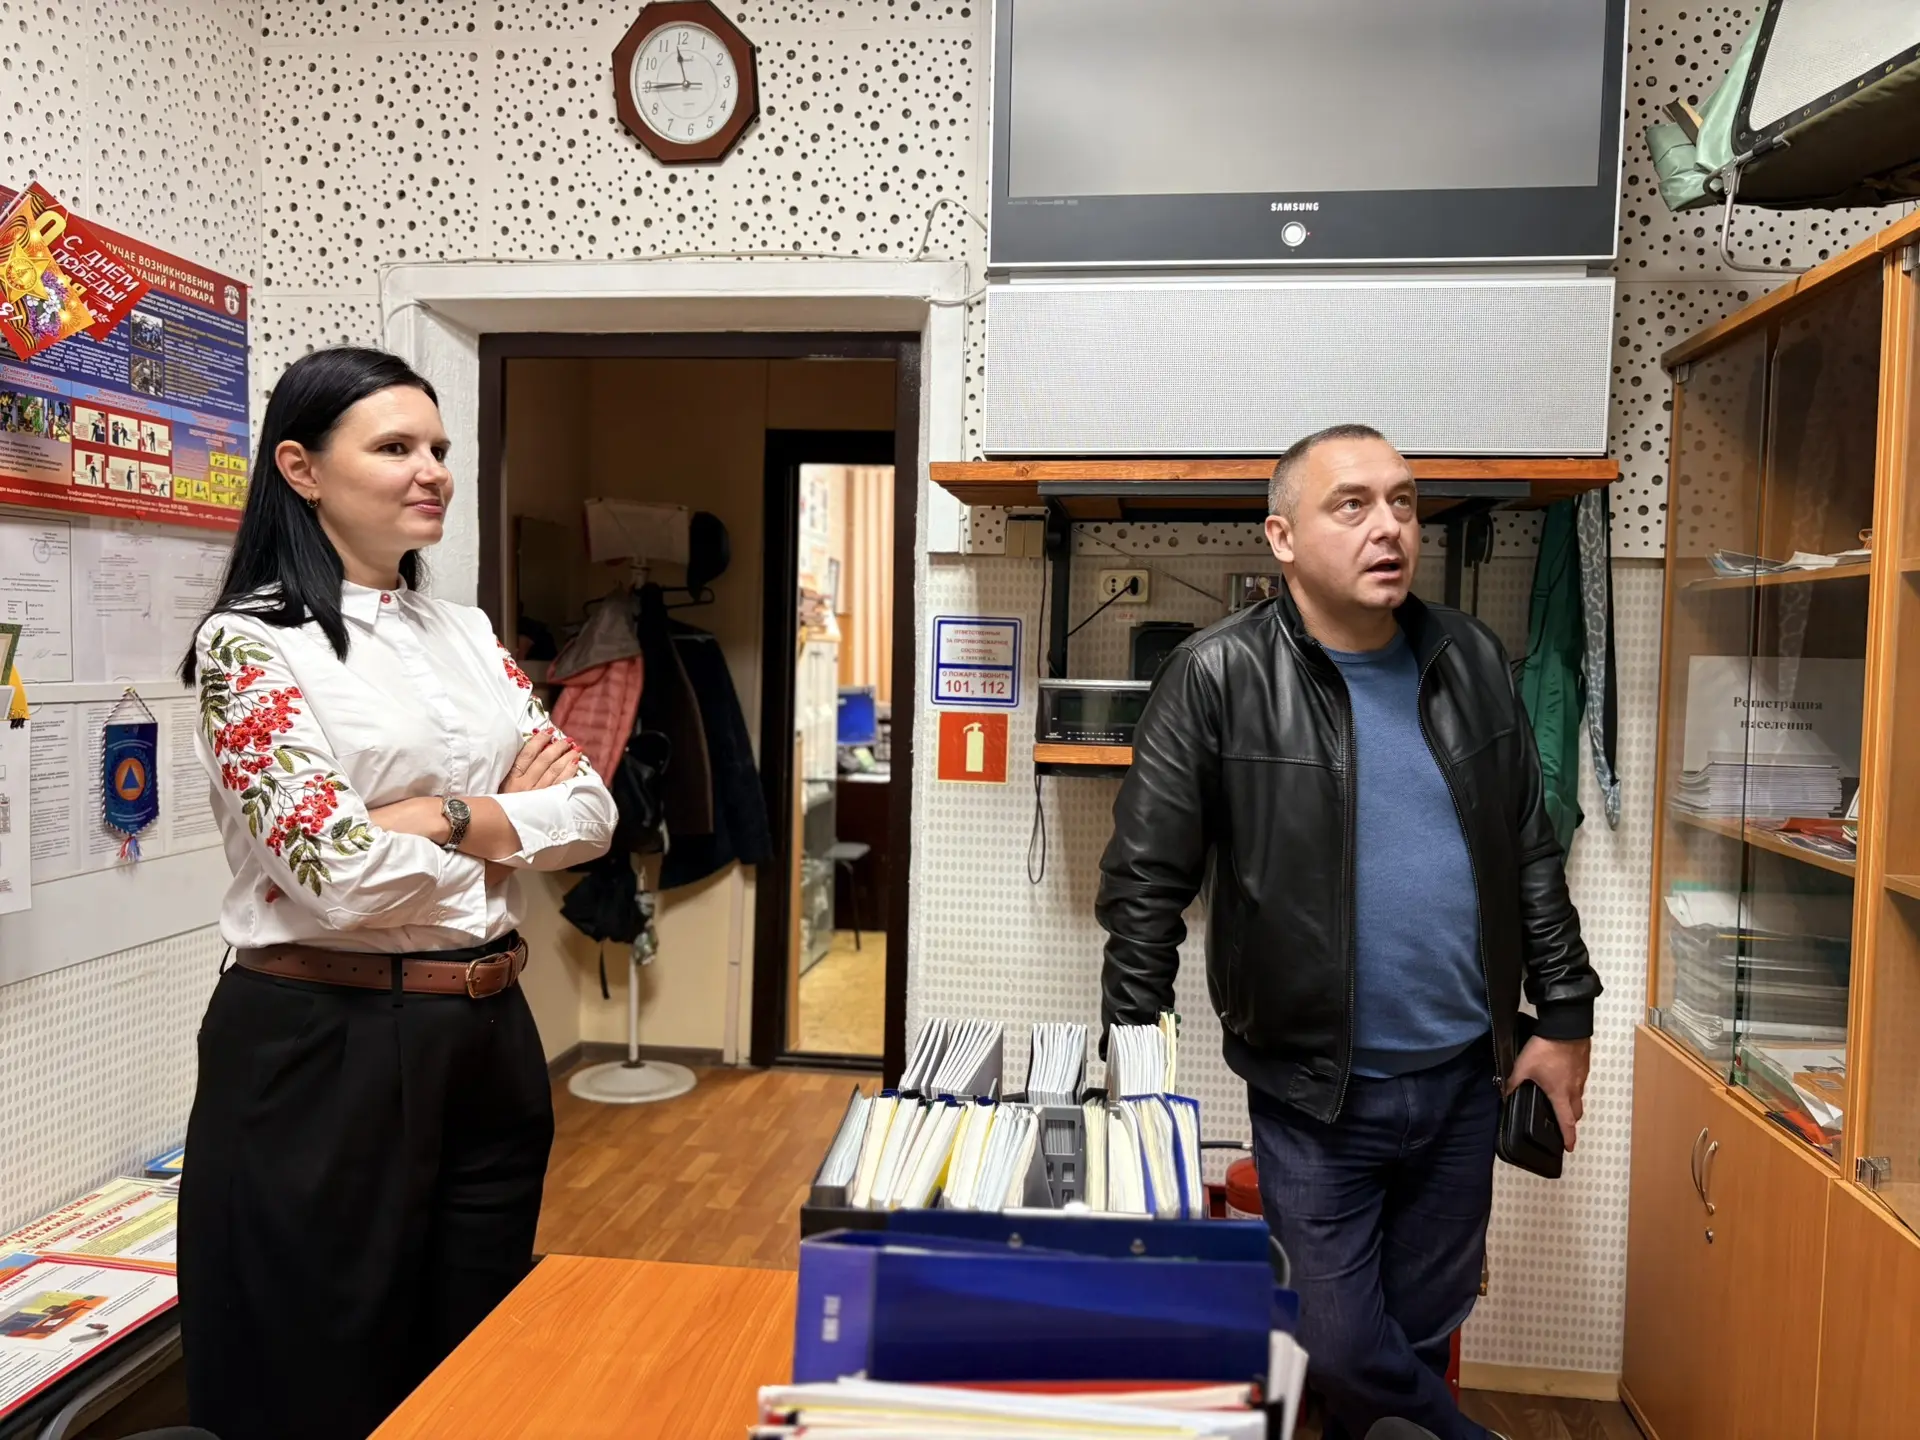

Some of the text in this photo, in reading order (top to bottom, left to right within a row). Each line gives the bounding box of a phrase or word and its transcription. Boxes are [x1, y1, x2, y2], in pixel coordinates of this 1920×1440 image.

[658, 39, 669, 52] 11
[677, 32, 689, 46] 12
[701, 37, 706, 50] 1
[645, 57, 657, 70] 10
[716, 53, 724, 66] 2
[723, 76, 731, 88] 3
[651, 102, 659, 115] 8
[720, 99, 727, 112] 4
[667, 119, 674, 132] 7
[706, 116, 714, 129] 5
[687, 123, 694, 136] 6
[1270, 202, 1320, 212] SAMSUNG
[63, 235, 83, 251] С
[80, 250, 140, 292] ДНЁМ
[100, 240, 215, 292] ЛУЧАЕ ВОЗНИКНОВЕНИЯ
[169, 280, 176, 291] И
[178, 284, 215, 305] ПОЖАРА
[978, 672, 1010, 680] ЗВОНИТЬ
[946, 680, 1005, 695] 101, 112
[1732, 696, 1823, 712] Регистрация
[1740, 720, 1813, 731] населения
[76, 1215, 124, 1239] ПОЖАР
